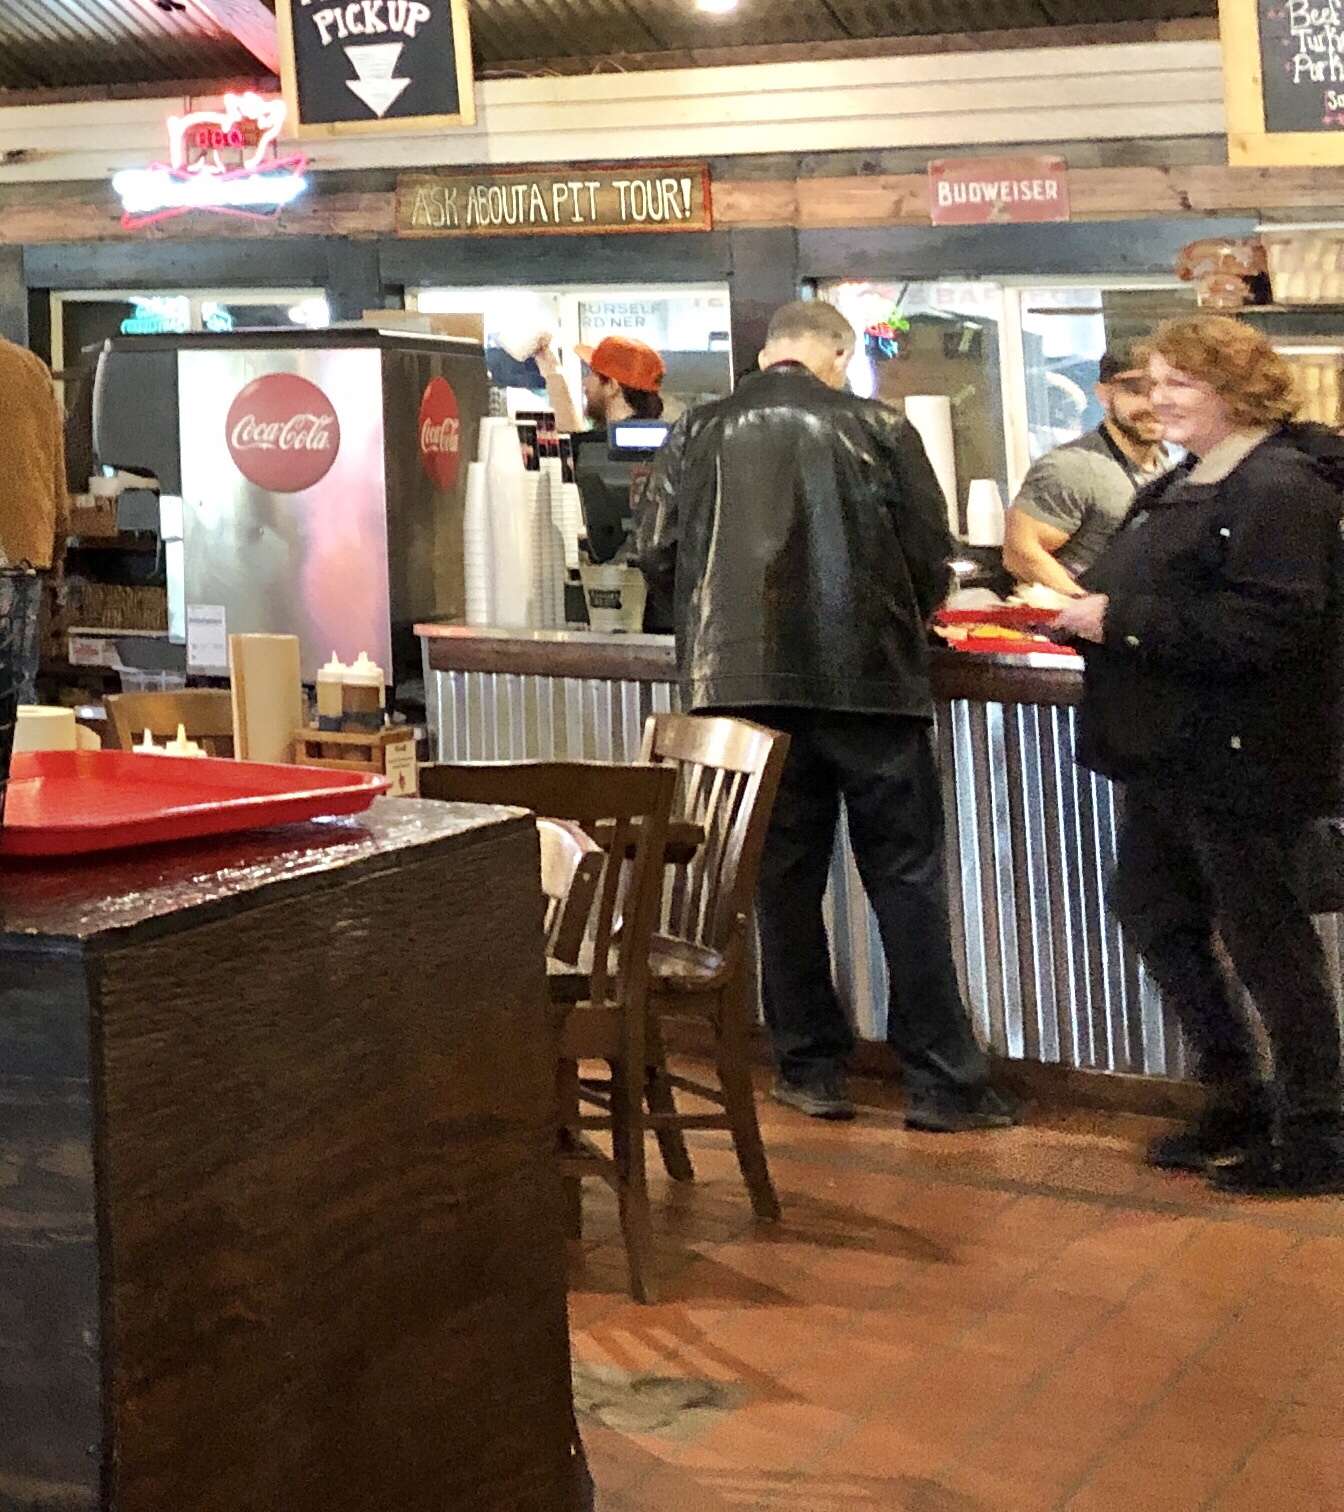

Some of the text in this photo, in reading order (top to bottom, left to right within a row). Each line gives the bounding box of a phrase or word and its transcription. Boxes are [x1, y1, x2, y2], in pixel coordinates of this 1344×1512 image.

[312, 0, 431, 46] PICKUP
[411, 177, 692, 227] ASK ABOUT A PIT TOUR!
[937, 178, 1059, 207] BUDWEISER
[231, 413, 335, 451] Coca-Cola
